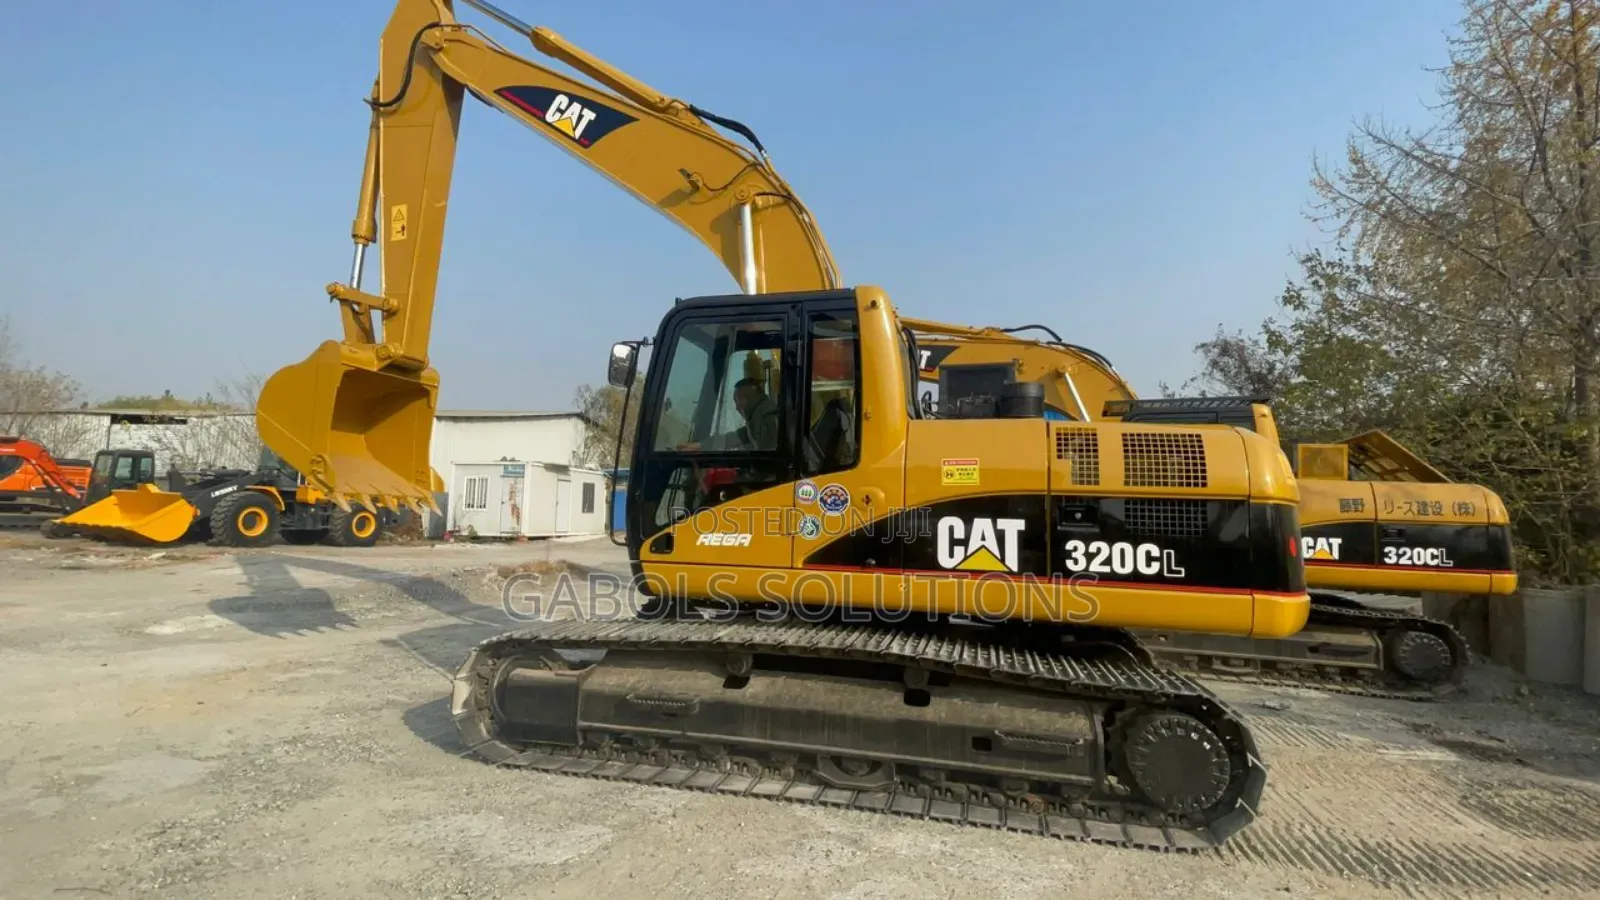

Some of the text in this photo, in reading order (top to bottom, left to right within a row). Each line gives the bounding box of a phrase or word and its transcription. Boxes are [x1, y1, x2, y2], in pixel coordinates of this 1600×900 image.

[545, 94, 597, 140] CAT
[937, 516, 1026, 572] CAT
[1301, 537, 1343, 560] CAT
[1384, 547, 1453, 567] 320CL
